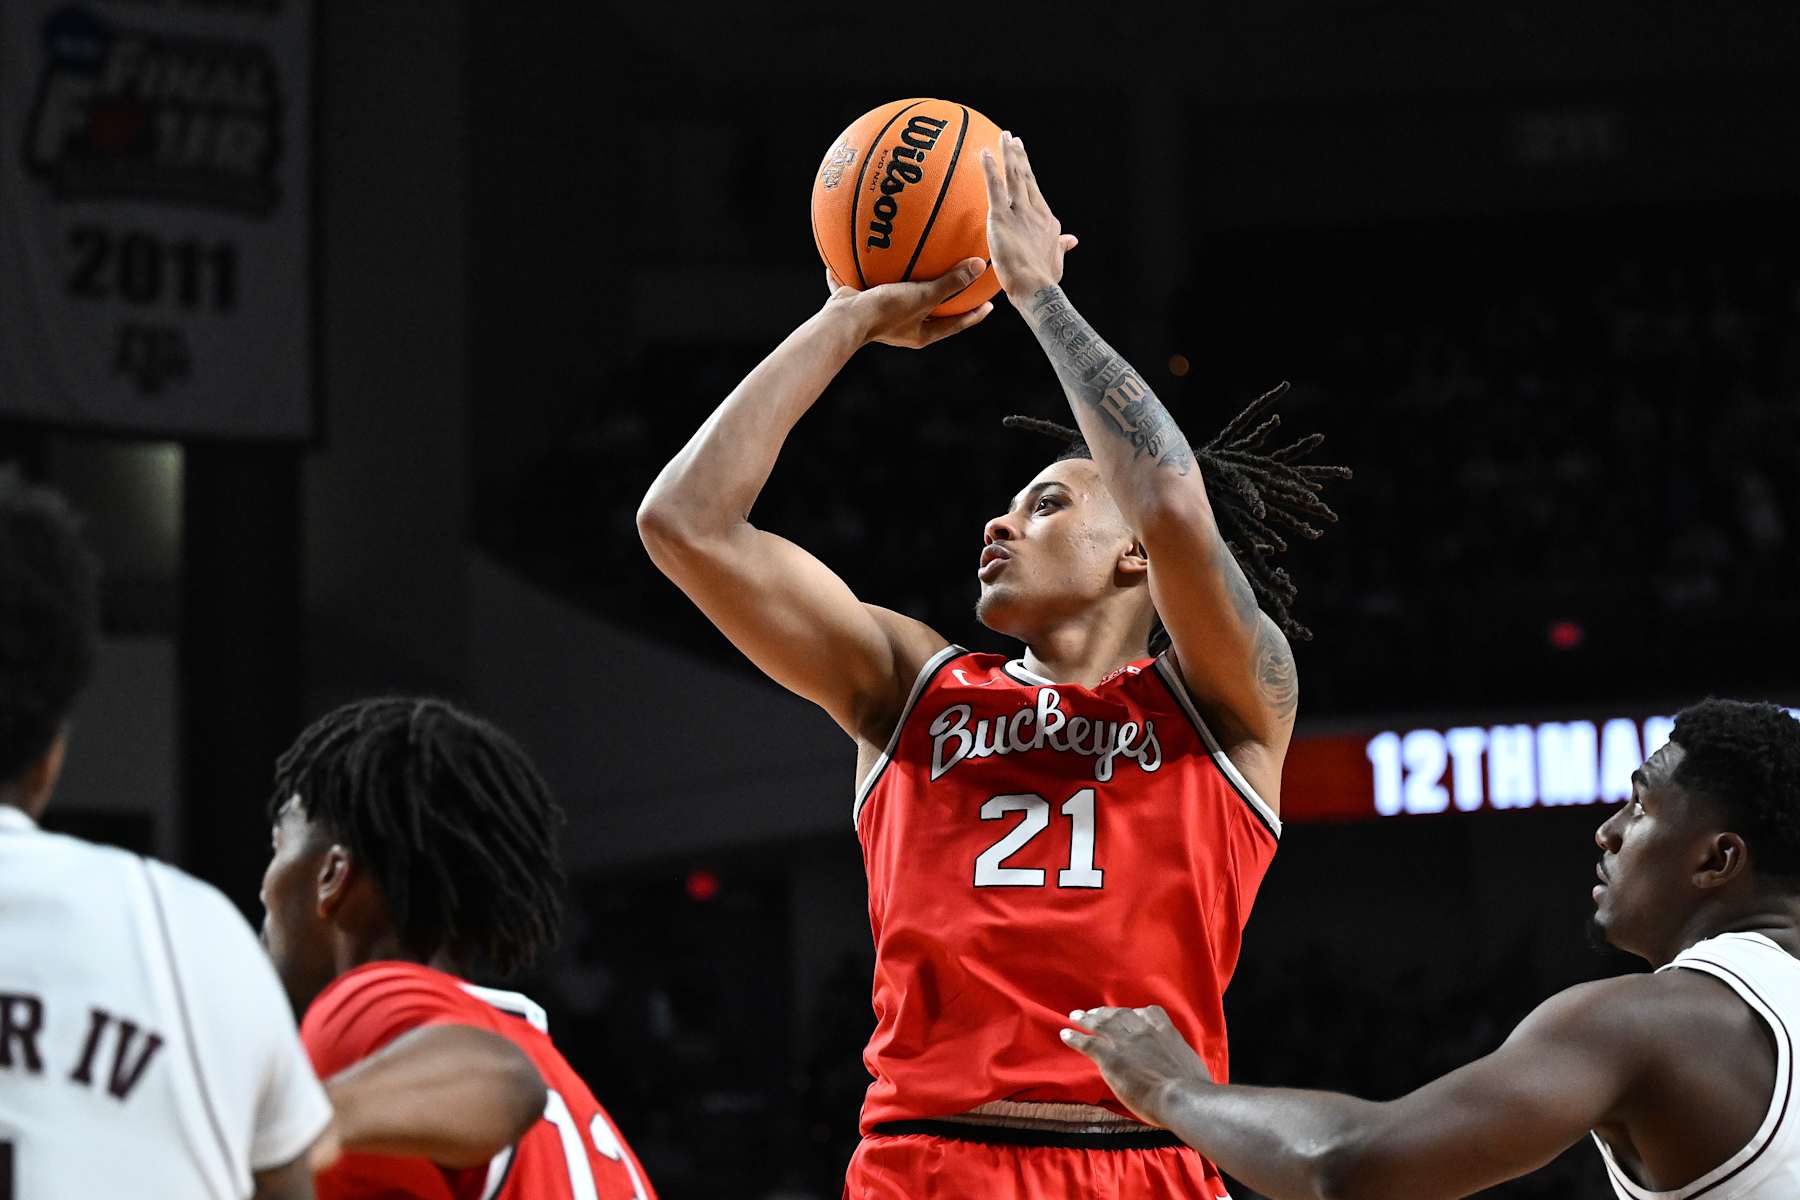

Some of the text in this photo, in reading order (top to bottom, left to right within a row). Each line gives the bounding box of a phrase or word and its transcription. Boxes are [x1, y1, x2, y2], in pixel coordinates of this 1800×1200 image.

[868, 115, 948, 249] Wilson
[68, 225, 238, 312] 2011
[929, 687, 1162, 782] Buckeyes
[973, 788, 1104, 888] 21
[70, 1007, 164, 1101] IV
